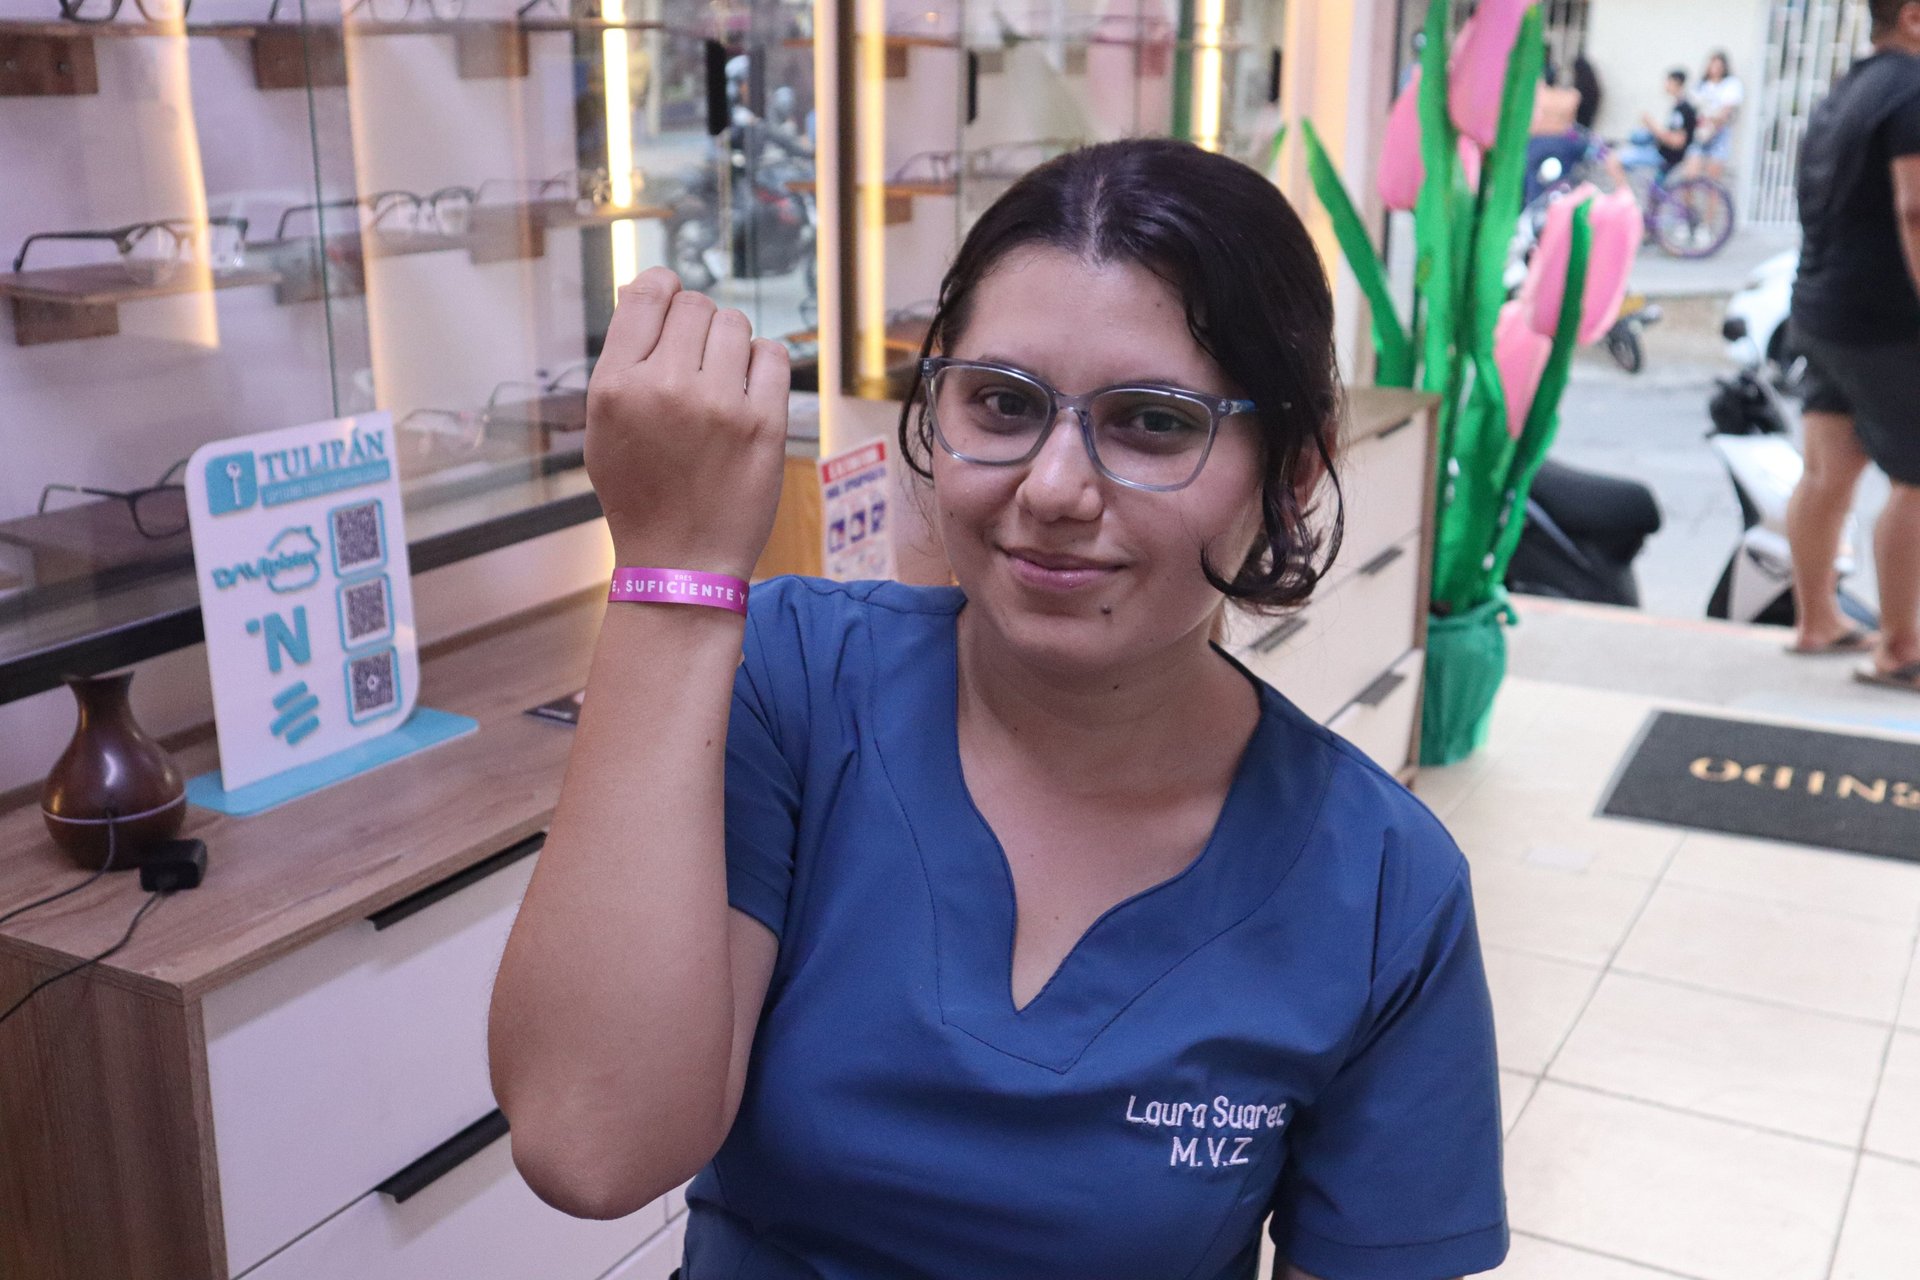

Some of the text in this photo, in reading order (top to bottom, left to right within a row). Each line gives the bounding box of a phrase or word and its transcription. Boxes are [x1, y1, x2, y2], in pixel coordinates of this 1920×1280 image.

[259, 428, 385, 482] TULIPÁN
[625, 579, 734, 602] SUFICIENTE
[674, 574, 692, 582] ERES
[1126, 1095, 1287, 1130] Laura Suarez
[1170, 1136, 1253, 1168] M.V.Z
